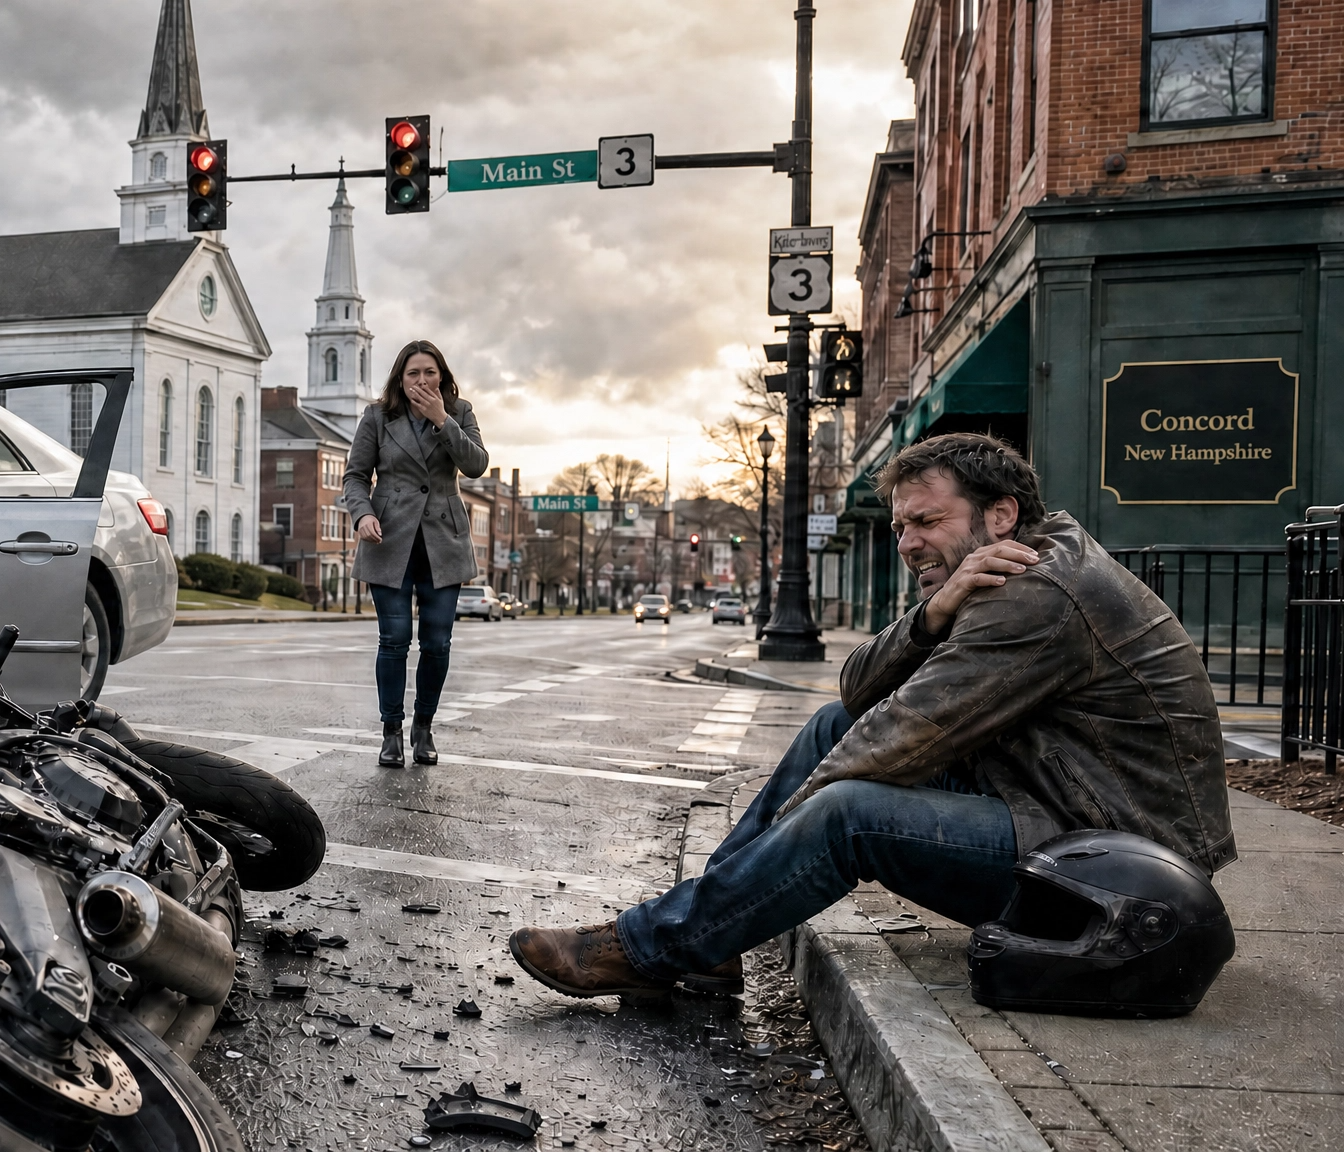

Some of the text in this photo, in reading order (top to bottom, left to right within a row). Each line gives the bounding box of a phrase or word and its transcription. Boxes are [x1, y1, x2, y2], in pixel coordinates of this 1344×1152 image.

[481, 158, 575, 184] Main St
[614, 147, 636, 176] 3
[788, 268, 813, 302] 3
[1140, 407, 1255, 432] Concord
[1124, 443, 1272, 465] New Hampshire
[537, 497, 587, 510] Main St
